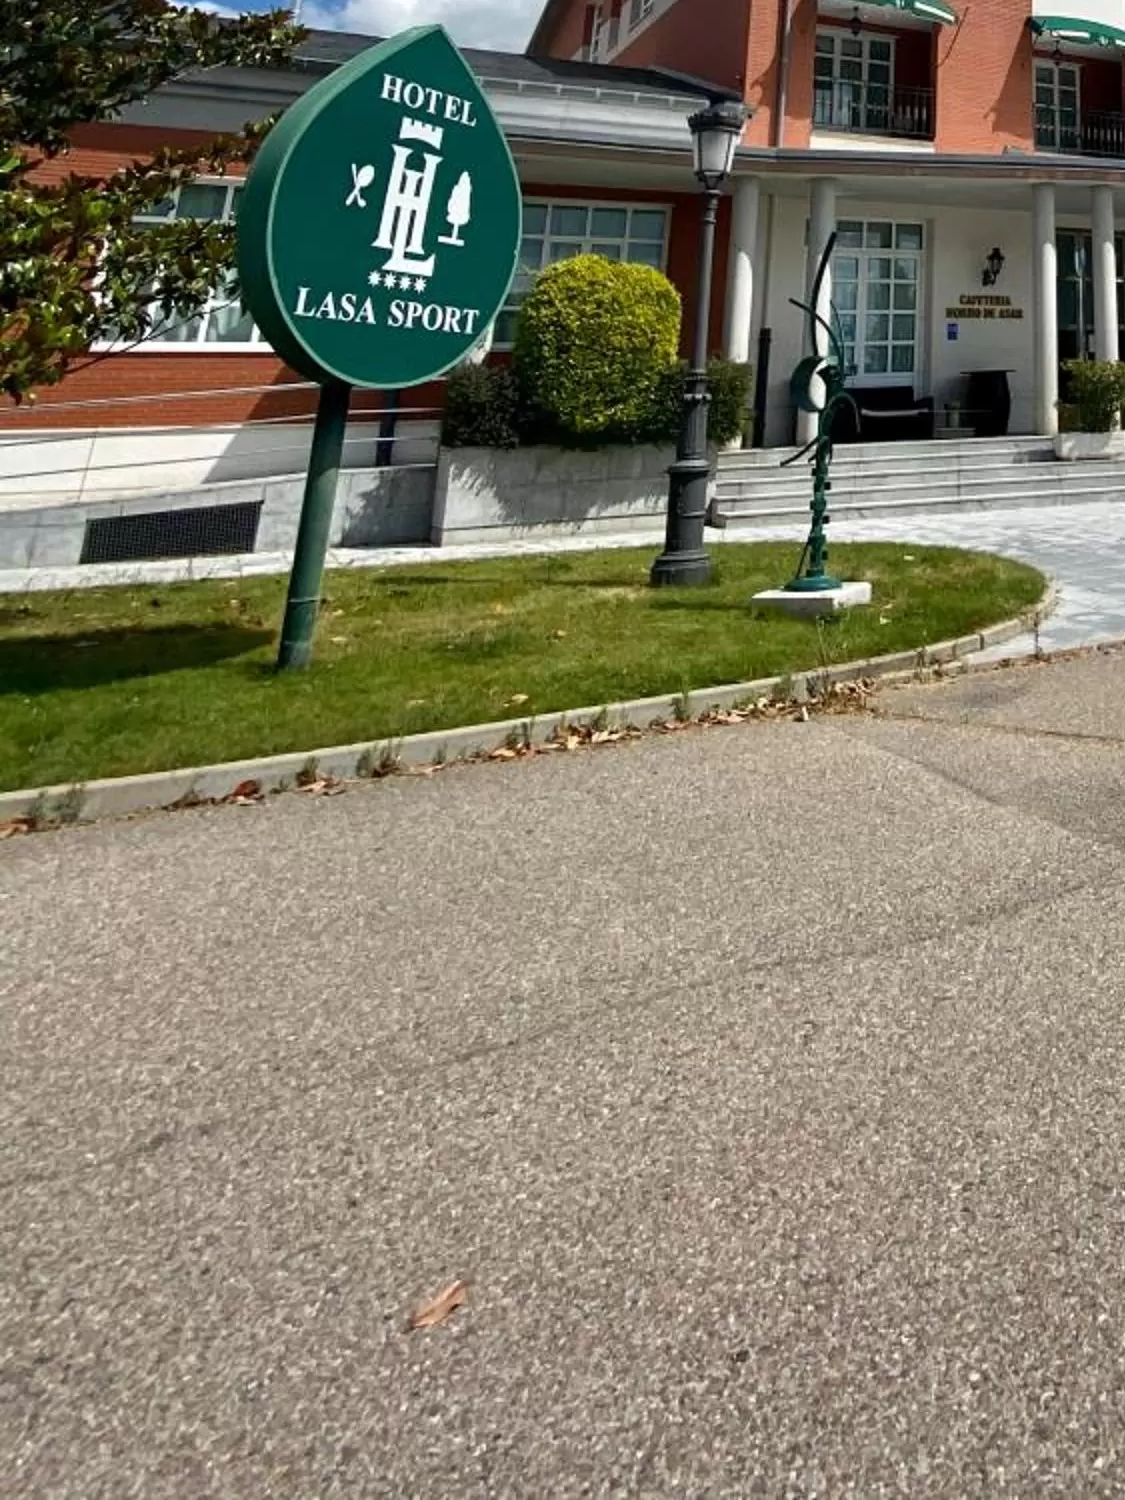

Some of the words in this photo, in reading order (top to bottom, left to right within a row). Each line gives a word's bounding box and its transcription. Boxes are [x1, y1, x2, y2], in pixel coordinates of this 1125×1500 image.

[380, 73, 478, 127] HOTEL
[293, 287, 377, 325] LASA
[387, 299, 480, 335] SPORT
